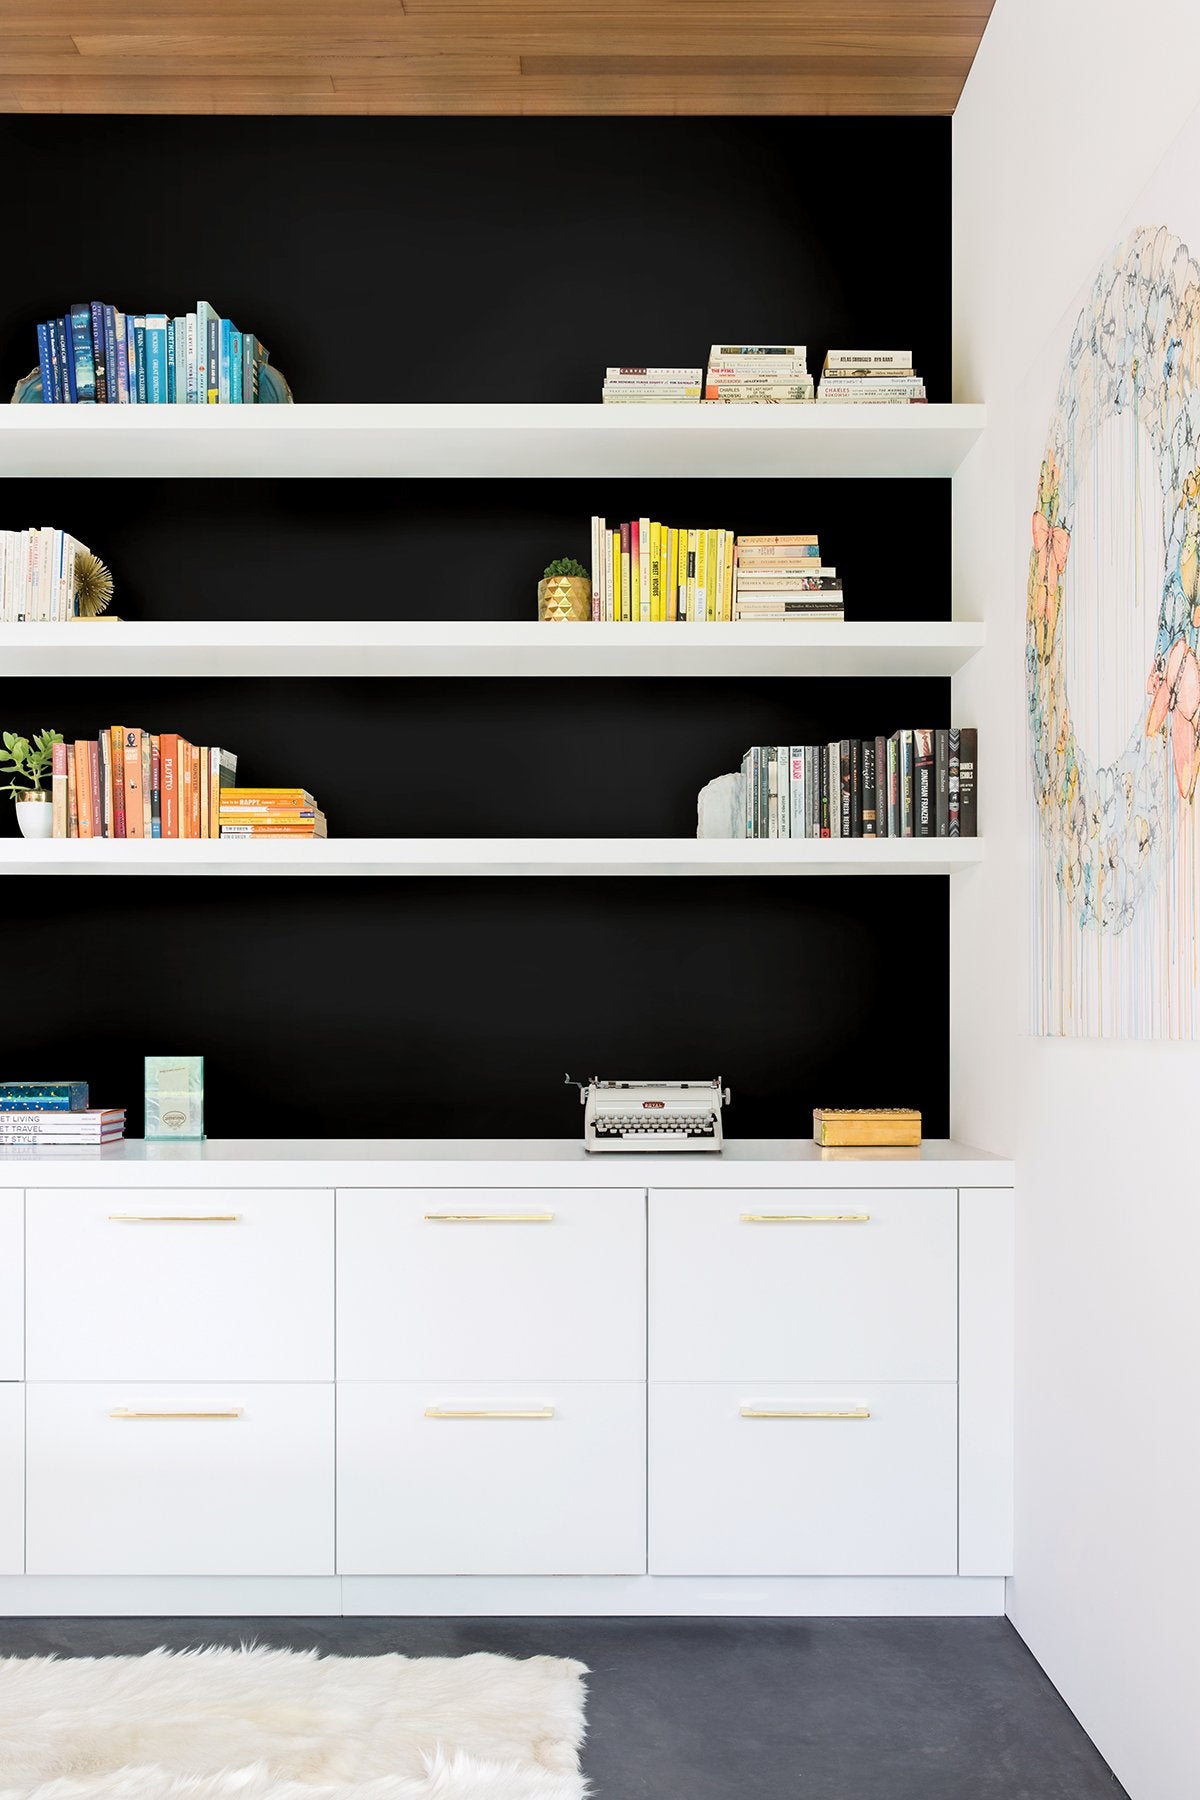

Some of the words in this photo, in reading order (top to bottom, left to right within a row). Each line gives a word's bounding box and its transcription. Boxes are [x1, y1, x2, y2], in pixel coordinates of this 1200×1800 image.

[165, 758, 173, 791] PLOTTO
[862, 749, 871, 790] Mockingbird
[920, 768, 929, 798] JONATHAN
[921, 798, 929, 824] FRANZEN
